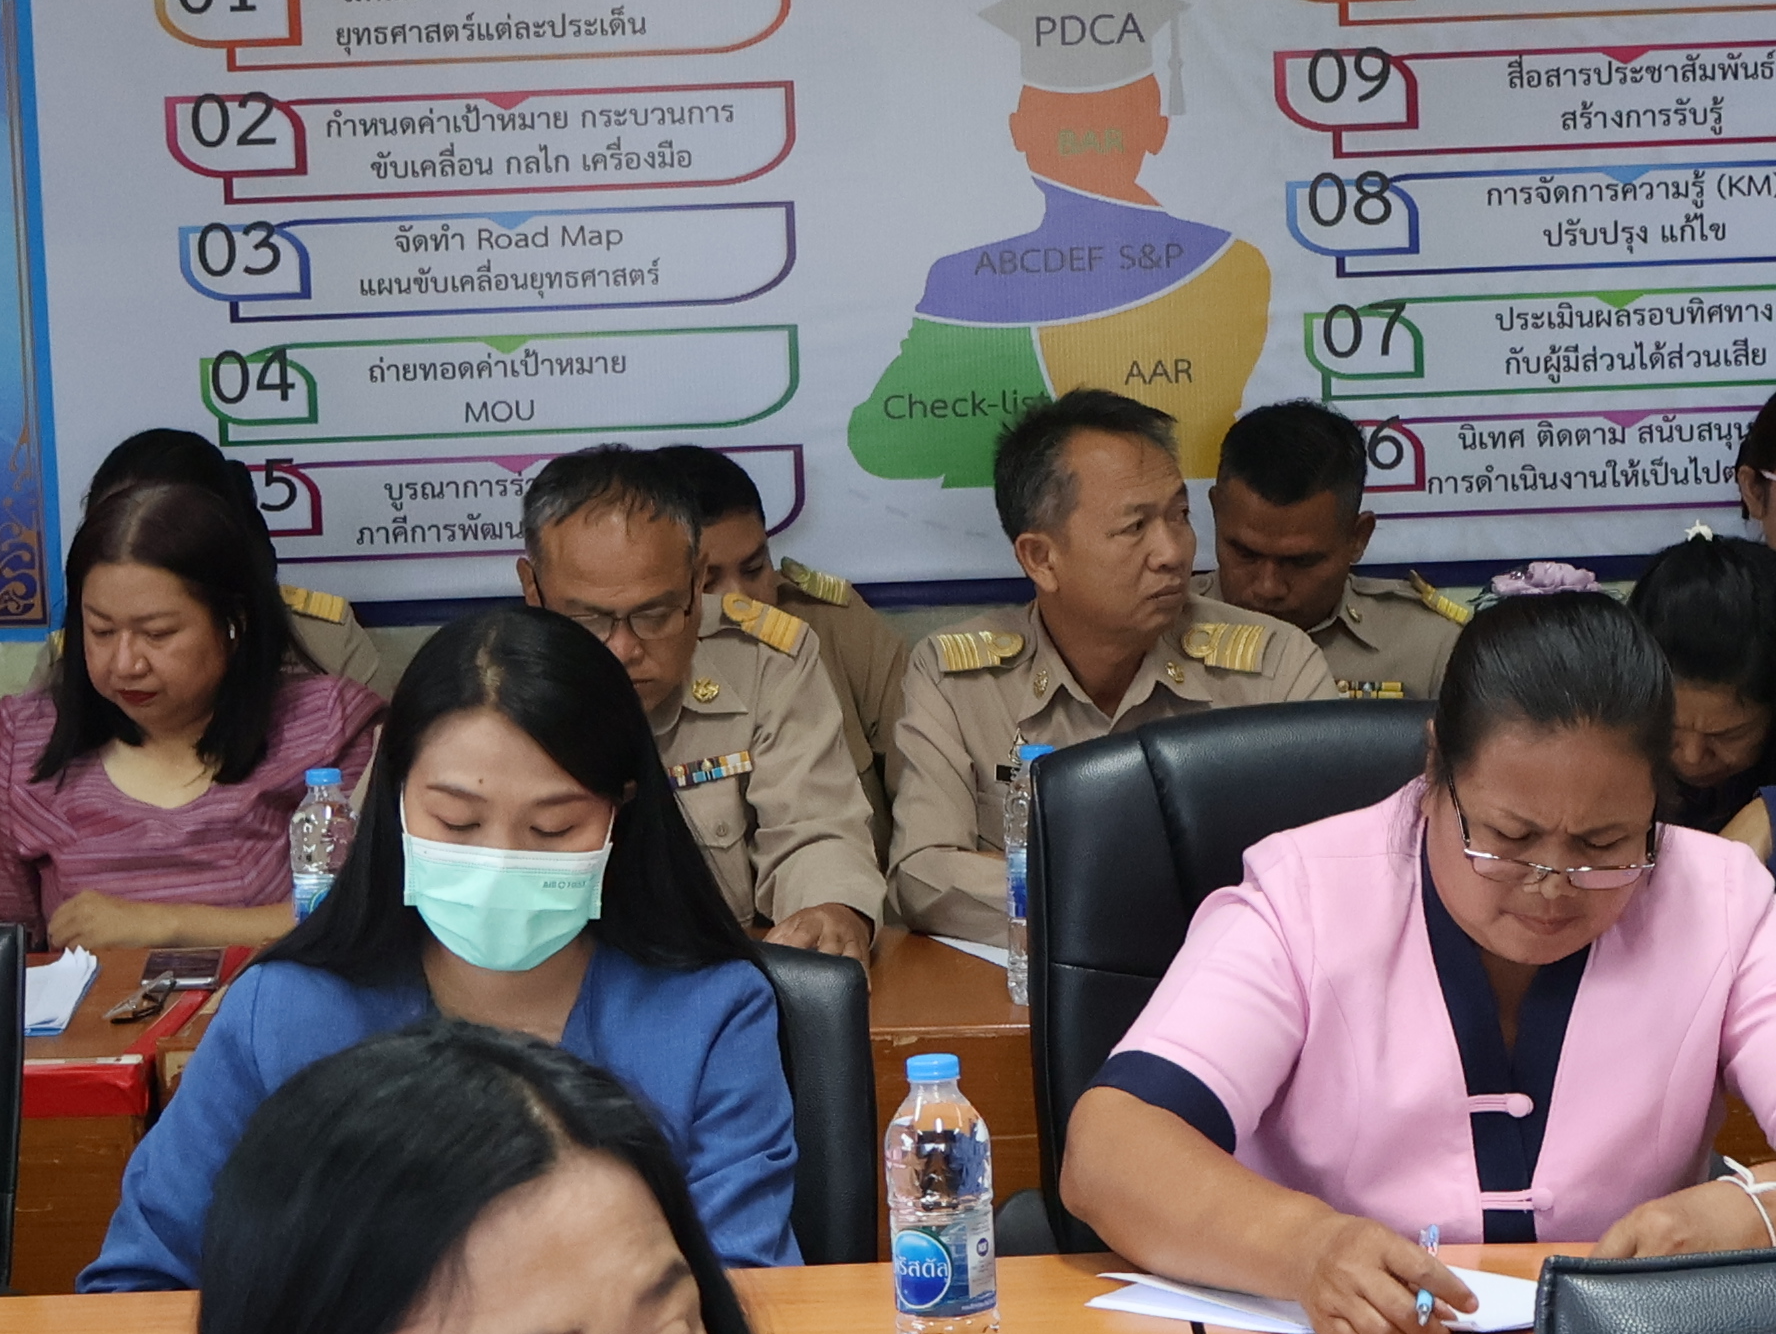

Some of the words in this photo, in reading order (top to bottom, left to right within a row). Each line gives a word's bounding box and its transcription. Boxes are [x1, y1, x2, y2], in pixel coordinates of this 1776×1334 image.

[334, 6, 648, 56] ยุทธศาสตร์แต่ละประเด็น
[1035, 11, 1147, 48] PDCA
[1307, 46, 1392, 104] 09
[190, 92, 279, 149] 02
[325, 101, 570, 142] กำหนดค่าเป้าหมาย
[580, 97, 736, 131] กระบวนการ
[1560, 95, 1726, 138] สร้างการรับรู้
[369, 147, 494, 184] ขับเคลื่อน
[507, 147, 571, 176] กลไก
[581, 135, 694, 174] เครื่องมือ
[1308, 171, 1394, 229] 08
[1485, 169, 1710, 213] การจัดการความรู้
[196, 221, 284, 279] 03
[394, 222, 466, 257] จัดทำ
[477, 223, 552, 253] Road
[561, 222, 624, 255] Map
[1542, 212, 1649, 255] ปรับปรุง
[1660, 211, 1728, 244] แก้ไข
[358, 257, 663, 300] แผนขับเคลื่อนยุทธศาสตร์
[975, 244, 1106, 278] ABCDEF
[1118, 240, 1185, 271] S&P
[1323, 302, 1407, 360] 07
[209, 349, 297, 405] 04
[367, 345, 628, 386] ถ่ายทอดค่าเป้าหมาย
[1123, 357, 1194, 385] AAR
[1504, 337, 1769, 385] กับผู้มีส่วนได้ส่วนเสีย
[463, 396, 536, 425] MOU
[1458, 422, 1525, 451] นิเทศ
[1536, 421, 1627, 449] ติดตาม
